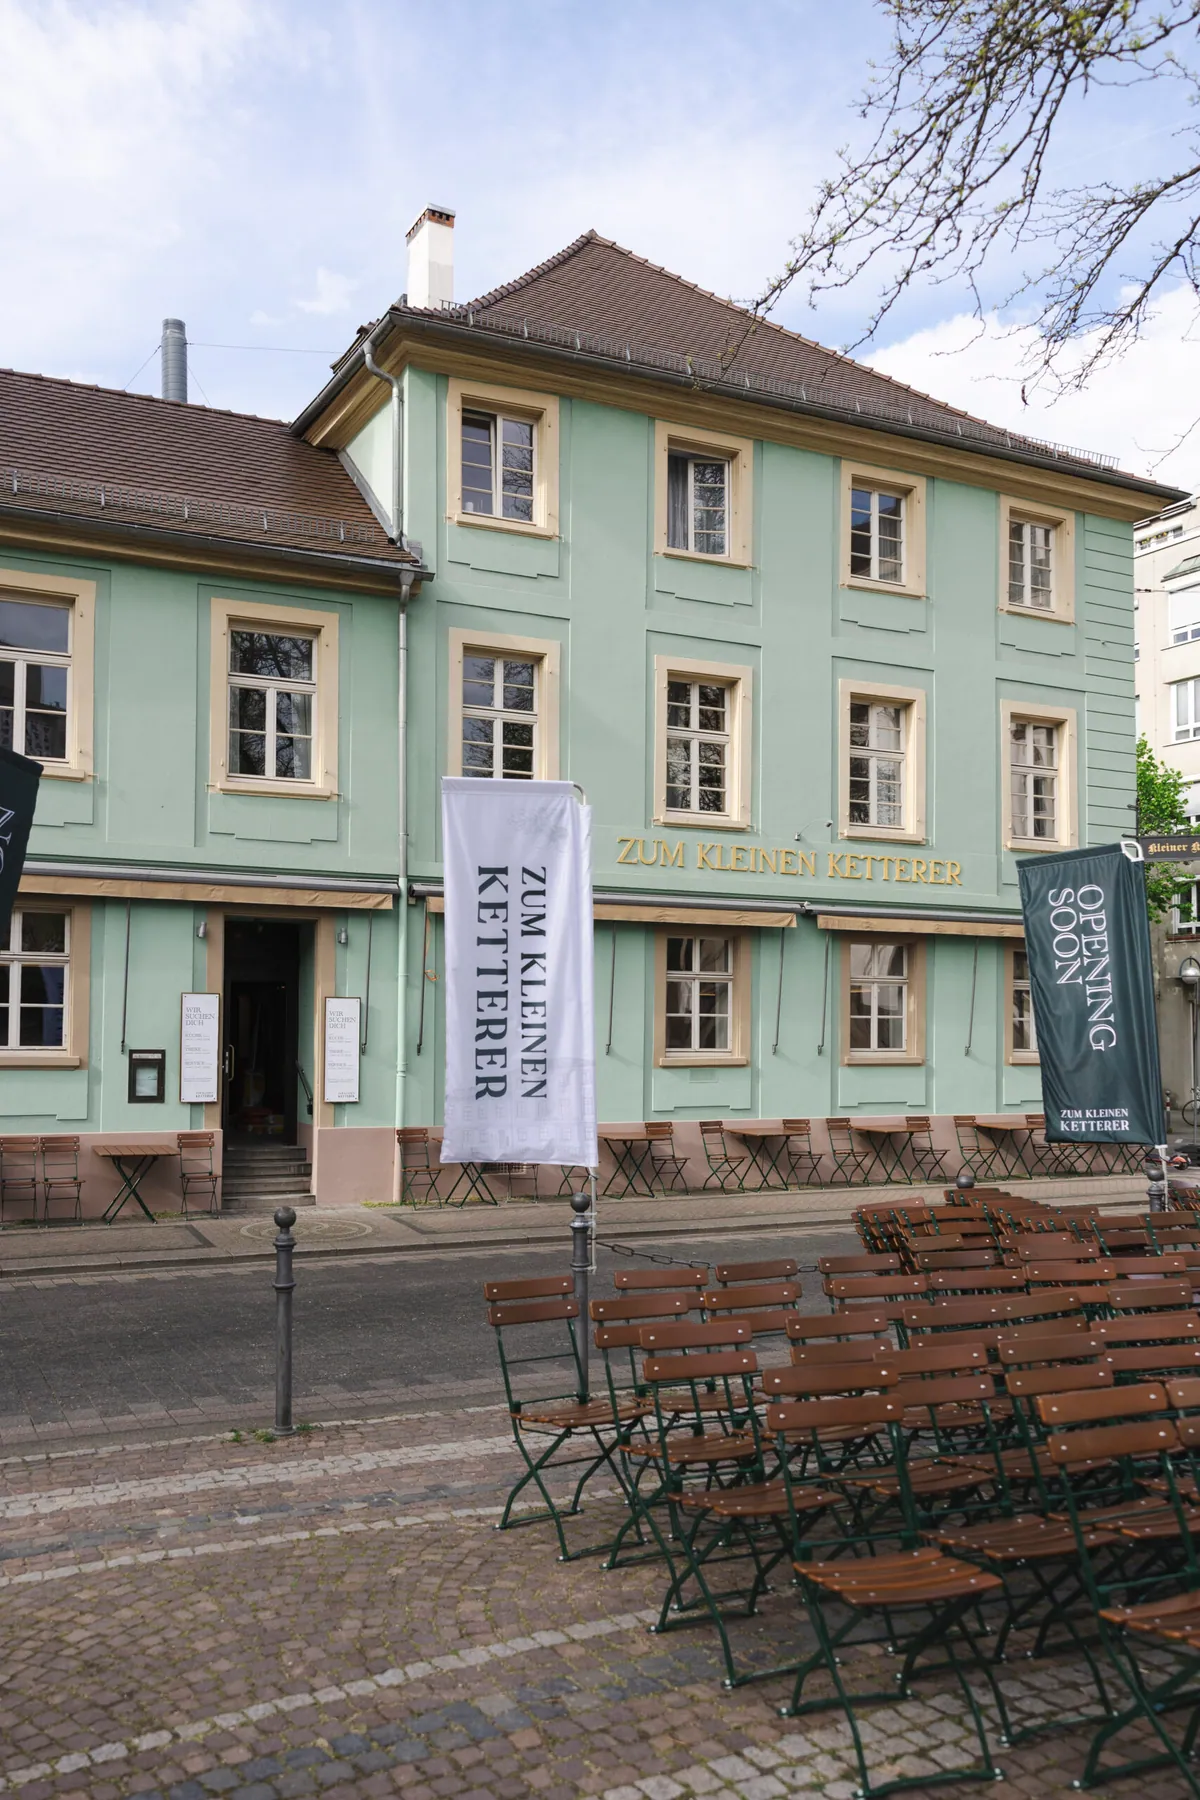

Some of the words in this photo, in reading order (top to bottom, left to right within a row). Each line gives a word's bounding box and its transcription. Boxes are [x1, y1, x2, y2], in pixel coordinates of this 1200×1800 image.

[616, 837, 685, 867] ZUM
[697, 843, 815, 876] KLEINEN
[827, 851, 964, 886] KETTERER
[1147, 842, 1189, 855] Kleiner
[520, 866, 547, 937] ZUM
[1048, 887, 1083, 985] SOON
[474, 865, 509, 1101] KETTERER
[1076, 883, 1117, 1052] OPENING
[520, 952, 548, 1099] KLEINEN
[1060, 1109, 1083, 1119] ZUM
[1085, 1108, 1129, 1118] KLEINEN
[1060, 1120, 1130, 1132] KETTERER
